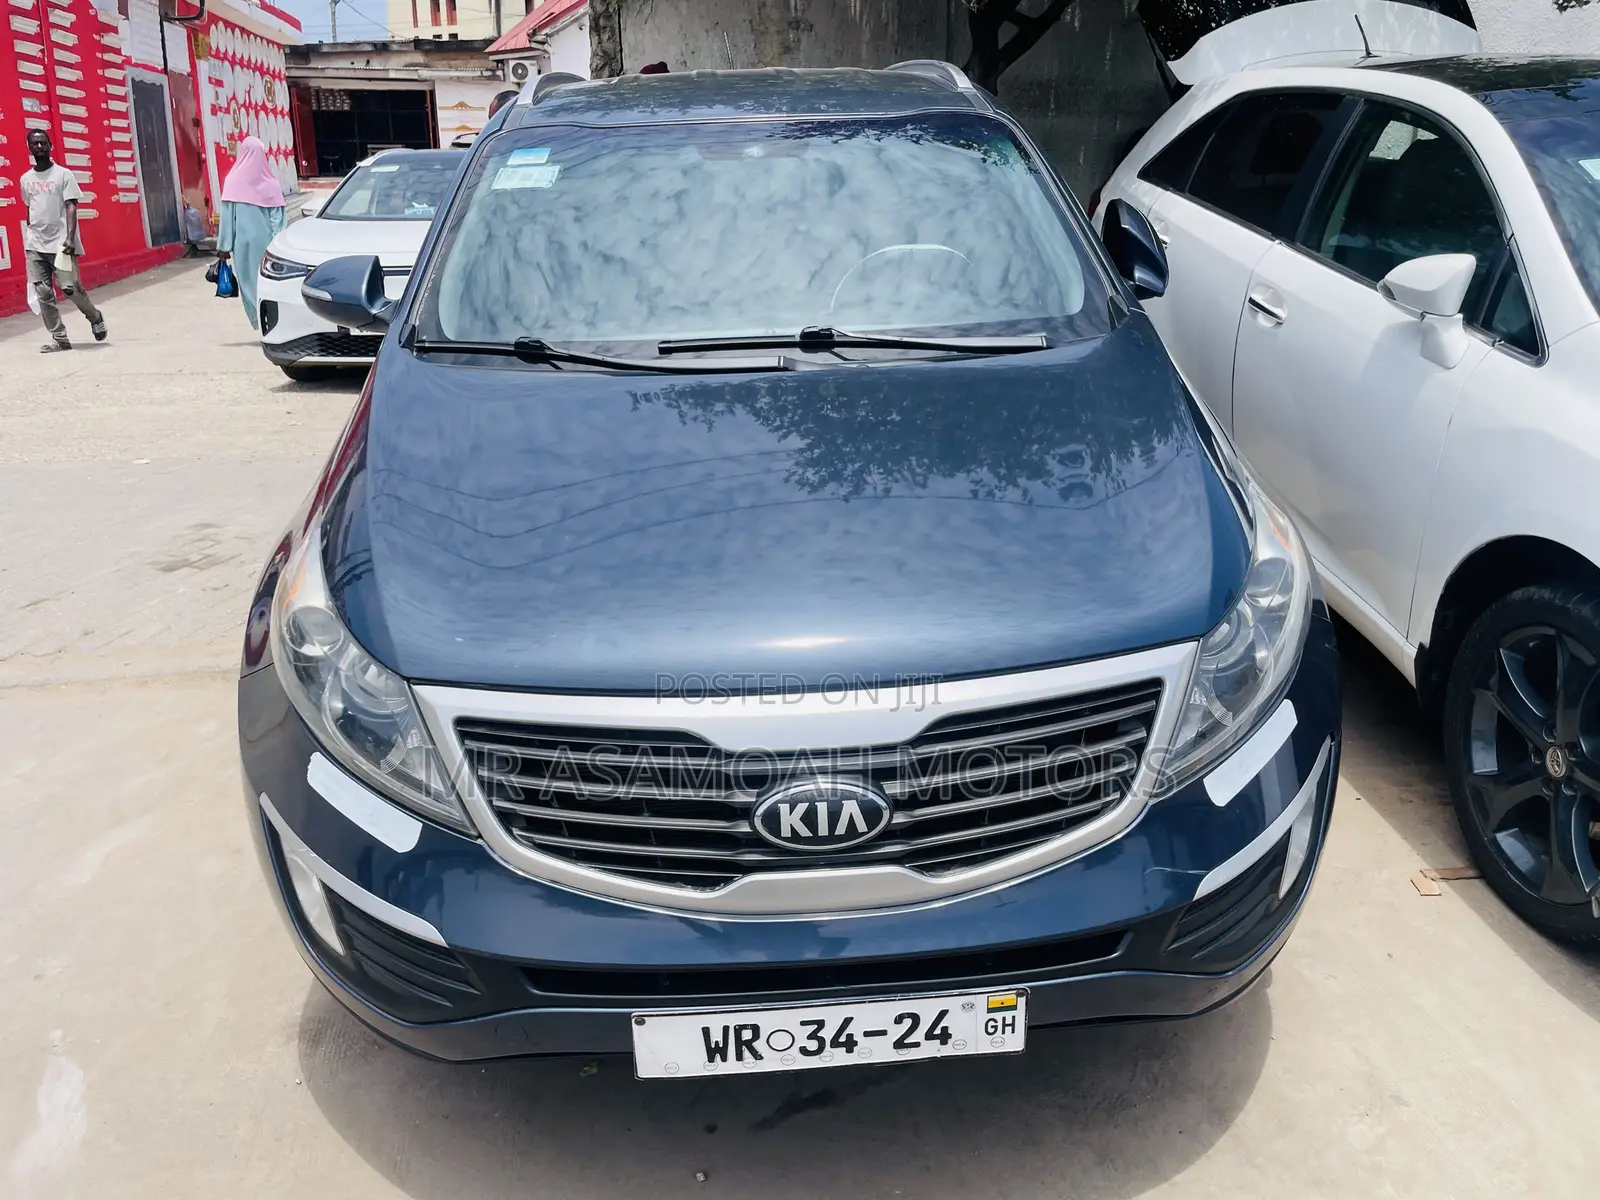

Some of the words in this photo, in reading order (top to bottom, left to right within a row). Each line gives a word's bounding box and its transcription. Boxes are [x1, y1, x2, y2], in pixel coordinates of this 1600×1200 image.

[778, 800, 869, 838] KIA
[701, 1023, 764, 1063] WR
[799, 1009, 953, 1057] 34-24
[984, 1015, 1016, 1036] GH
